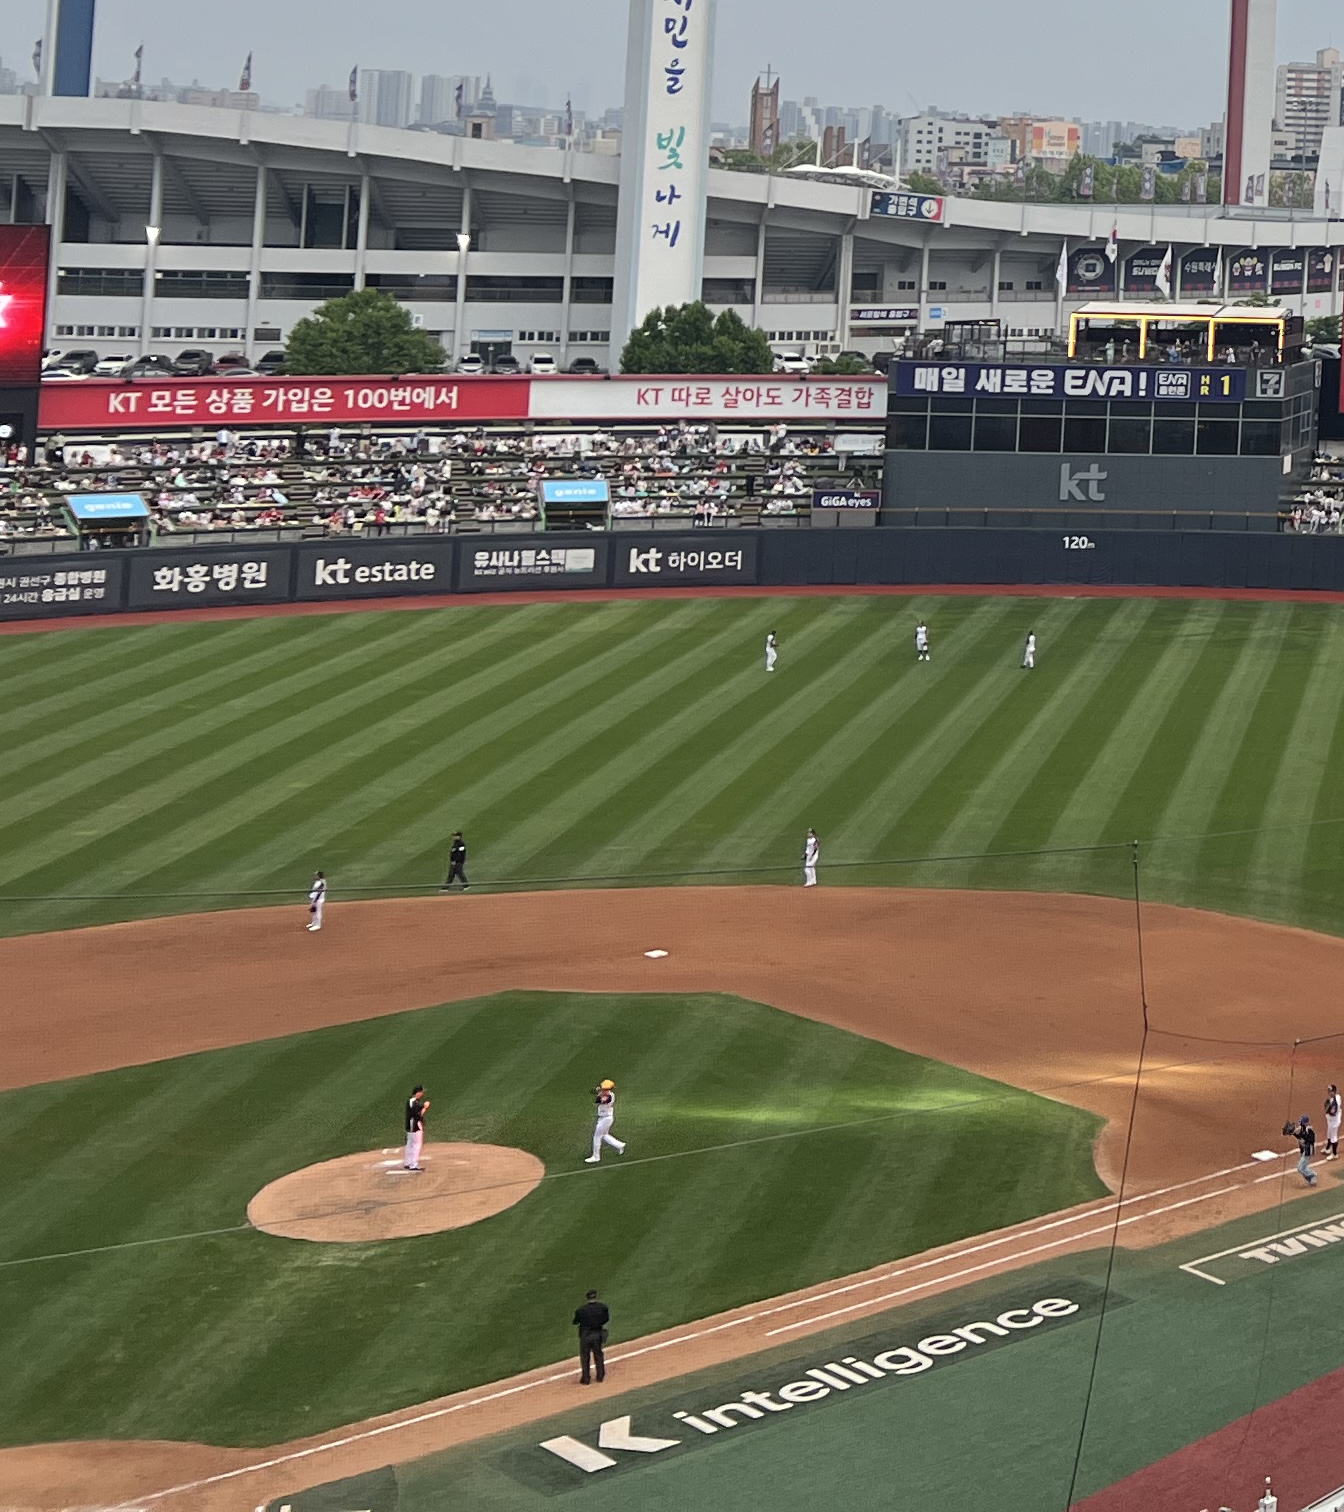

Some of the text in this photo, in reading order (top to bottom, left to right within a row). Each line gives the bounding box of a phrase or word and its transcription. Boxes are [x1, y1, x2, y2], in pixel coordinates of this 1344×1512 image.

[914, 367, 966, 393] 매일
[975, 368, 1055, 393] 새로운
[1219, 375, 1230, 396] 1
[108, 385, 459, 414] KT 모든 상품 가입은 100번에서
[637, 385, 874, 409] KT 따로 살아도 가족결합
[554, 486, 597, 498] genie
[1059, 463, 1108, 502] kt
[83, 500, 135, 514] genie
[847, 497, 872, 509] eyes
[315, 558, 436, 586] kt estate
[629, 547, 743, 573] kt 하이오더
[153, 561, 268, 592] 화홍병원
[3, 591, 38, 604] 24시간
[42, 587, 81, 602] 응급실
[539, 1293, 1081, 1474] K intelligence
